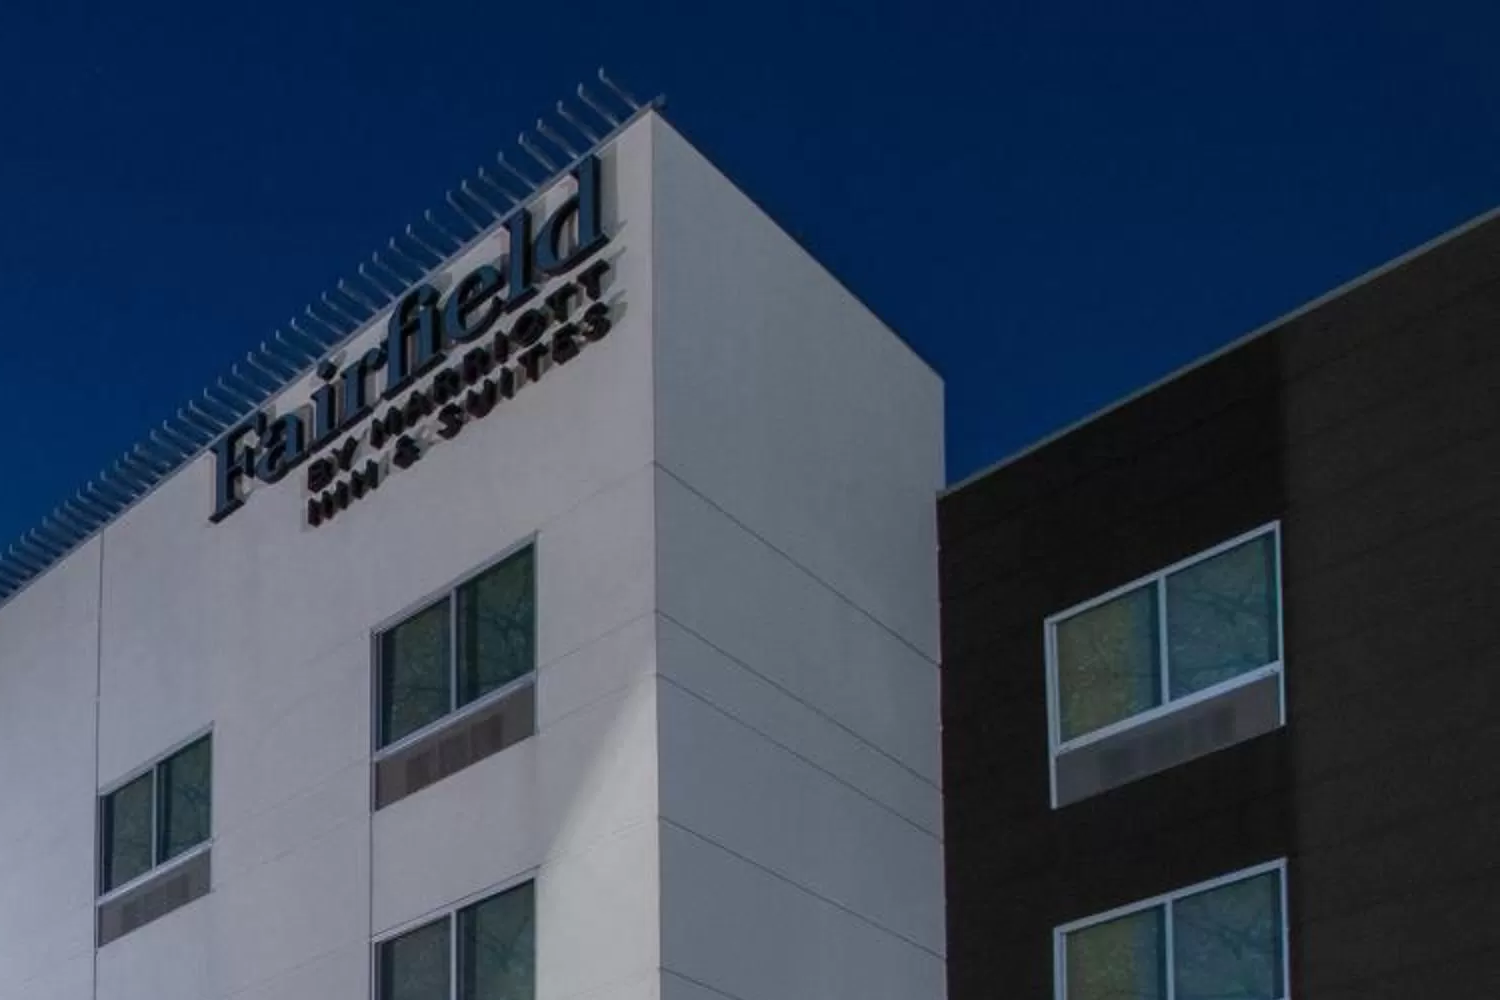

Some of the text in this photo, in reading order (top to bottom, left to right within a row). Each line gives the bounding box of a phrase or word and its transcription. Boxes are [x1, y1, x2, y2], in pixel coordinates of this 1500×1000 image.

[209, 153, 610, 523] Fairfield
[307, 259, 610, 493] BY MARRIOTT
[307, 301, 611, 526] INN & SUITES
